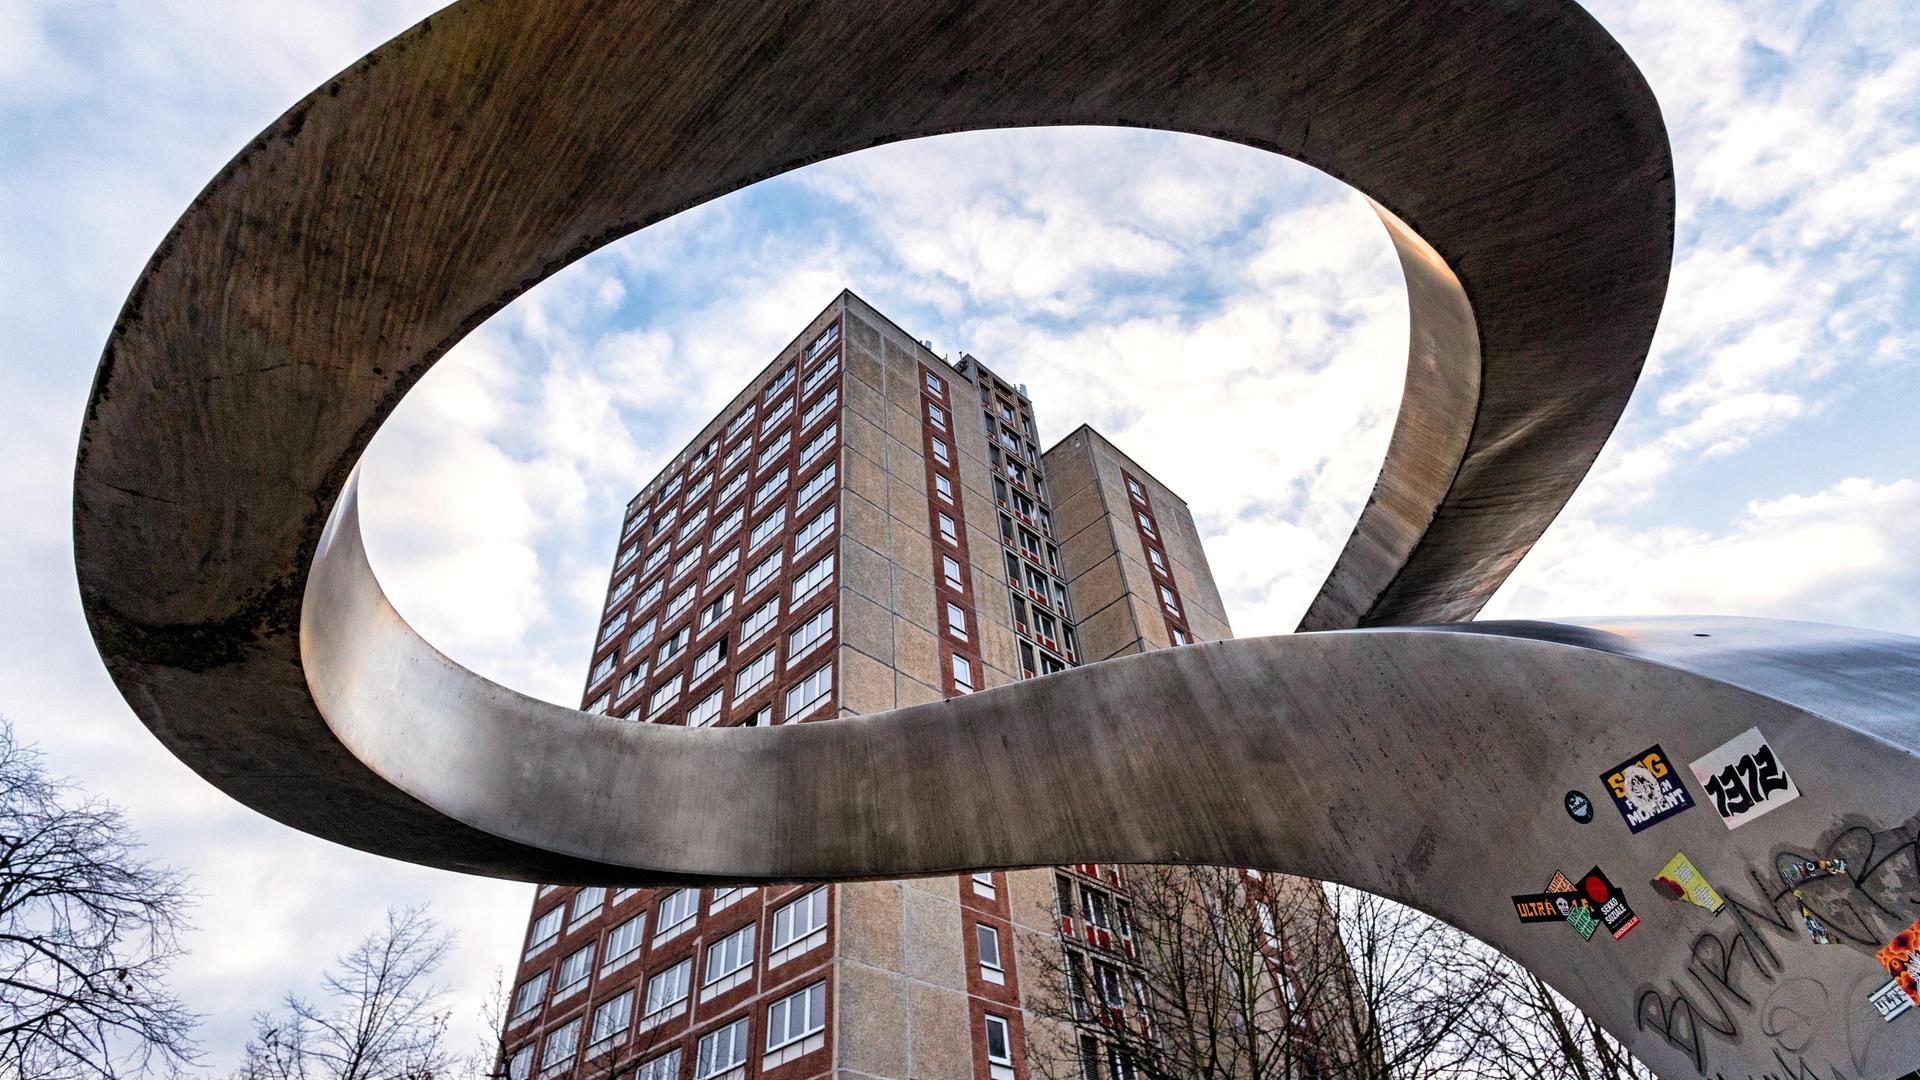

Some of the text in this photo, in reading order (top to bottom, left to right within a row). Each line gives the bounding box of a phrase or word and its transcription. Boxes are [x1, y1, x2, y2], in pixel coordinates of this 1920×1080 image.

[1607, 753, 1668, 798] SG
[1627, 788, 1686, 826] MOMENT
[1600, 897, 1619, 916] SEKKO
[1605, 903, 1627, 925] SOZIALE
[1874, 985, 1911, 1017] ULTR
